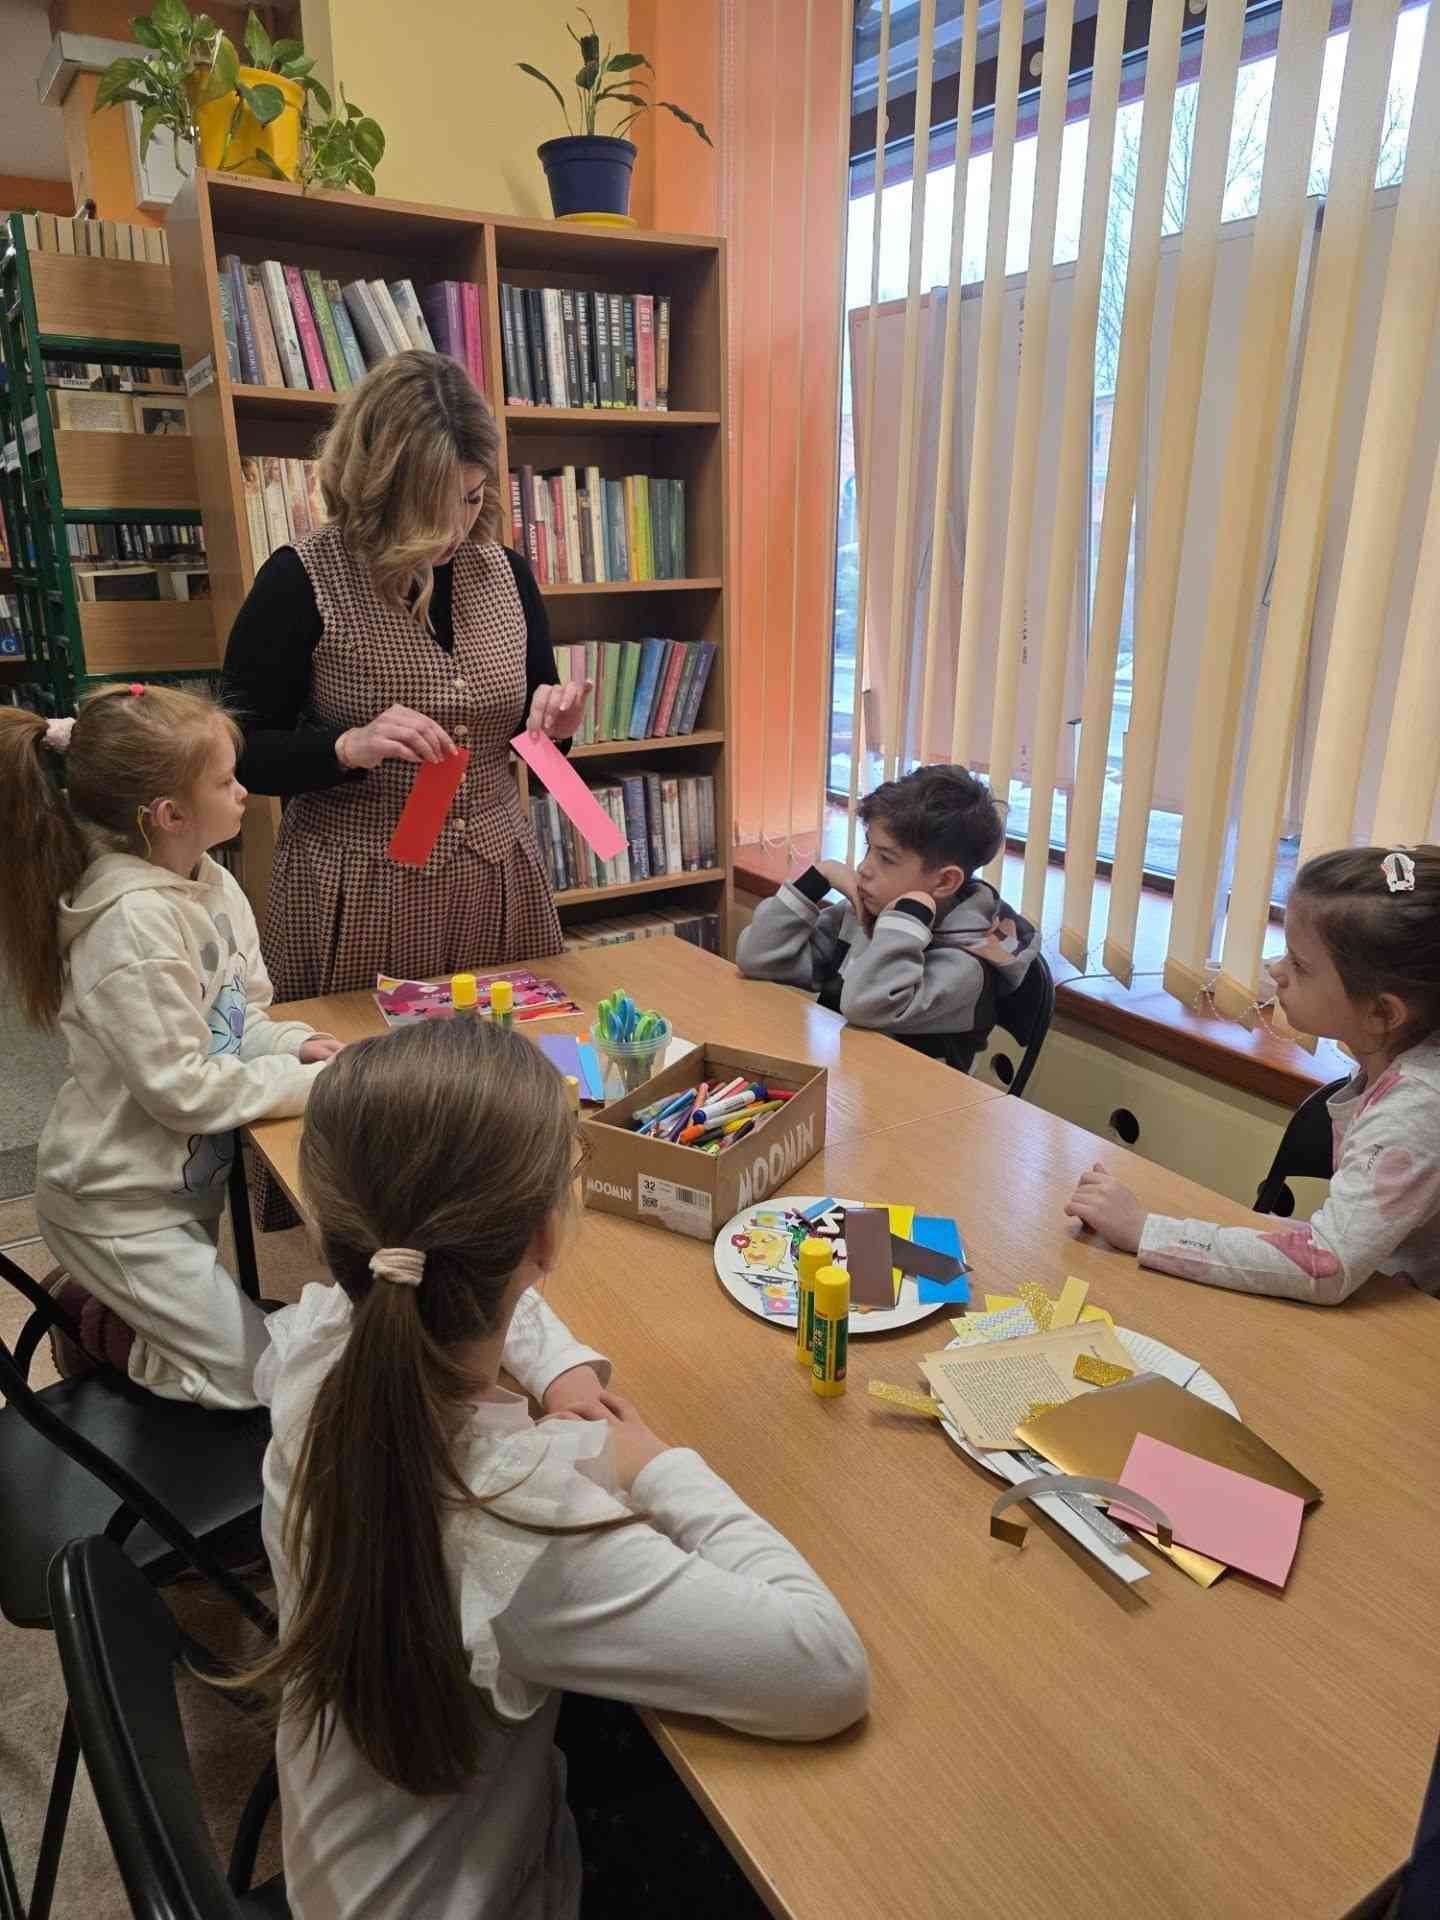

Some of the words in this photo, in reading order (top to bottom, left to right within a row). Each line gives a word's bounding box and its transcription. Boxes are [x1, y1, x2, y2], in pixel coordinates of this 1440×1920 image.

[529, 524, 538, 560] AGENT
[738, 1113, 815, 1213] MOOMIN
[589, 1178, 632, 1200] MOOMIN
[643, 1179, 656, 1192] 32
